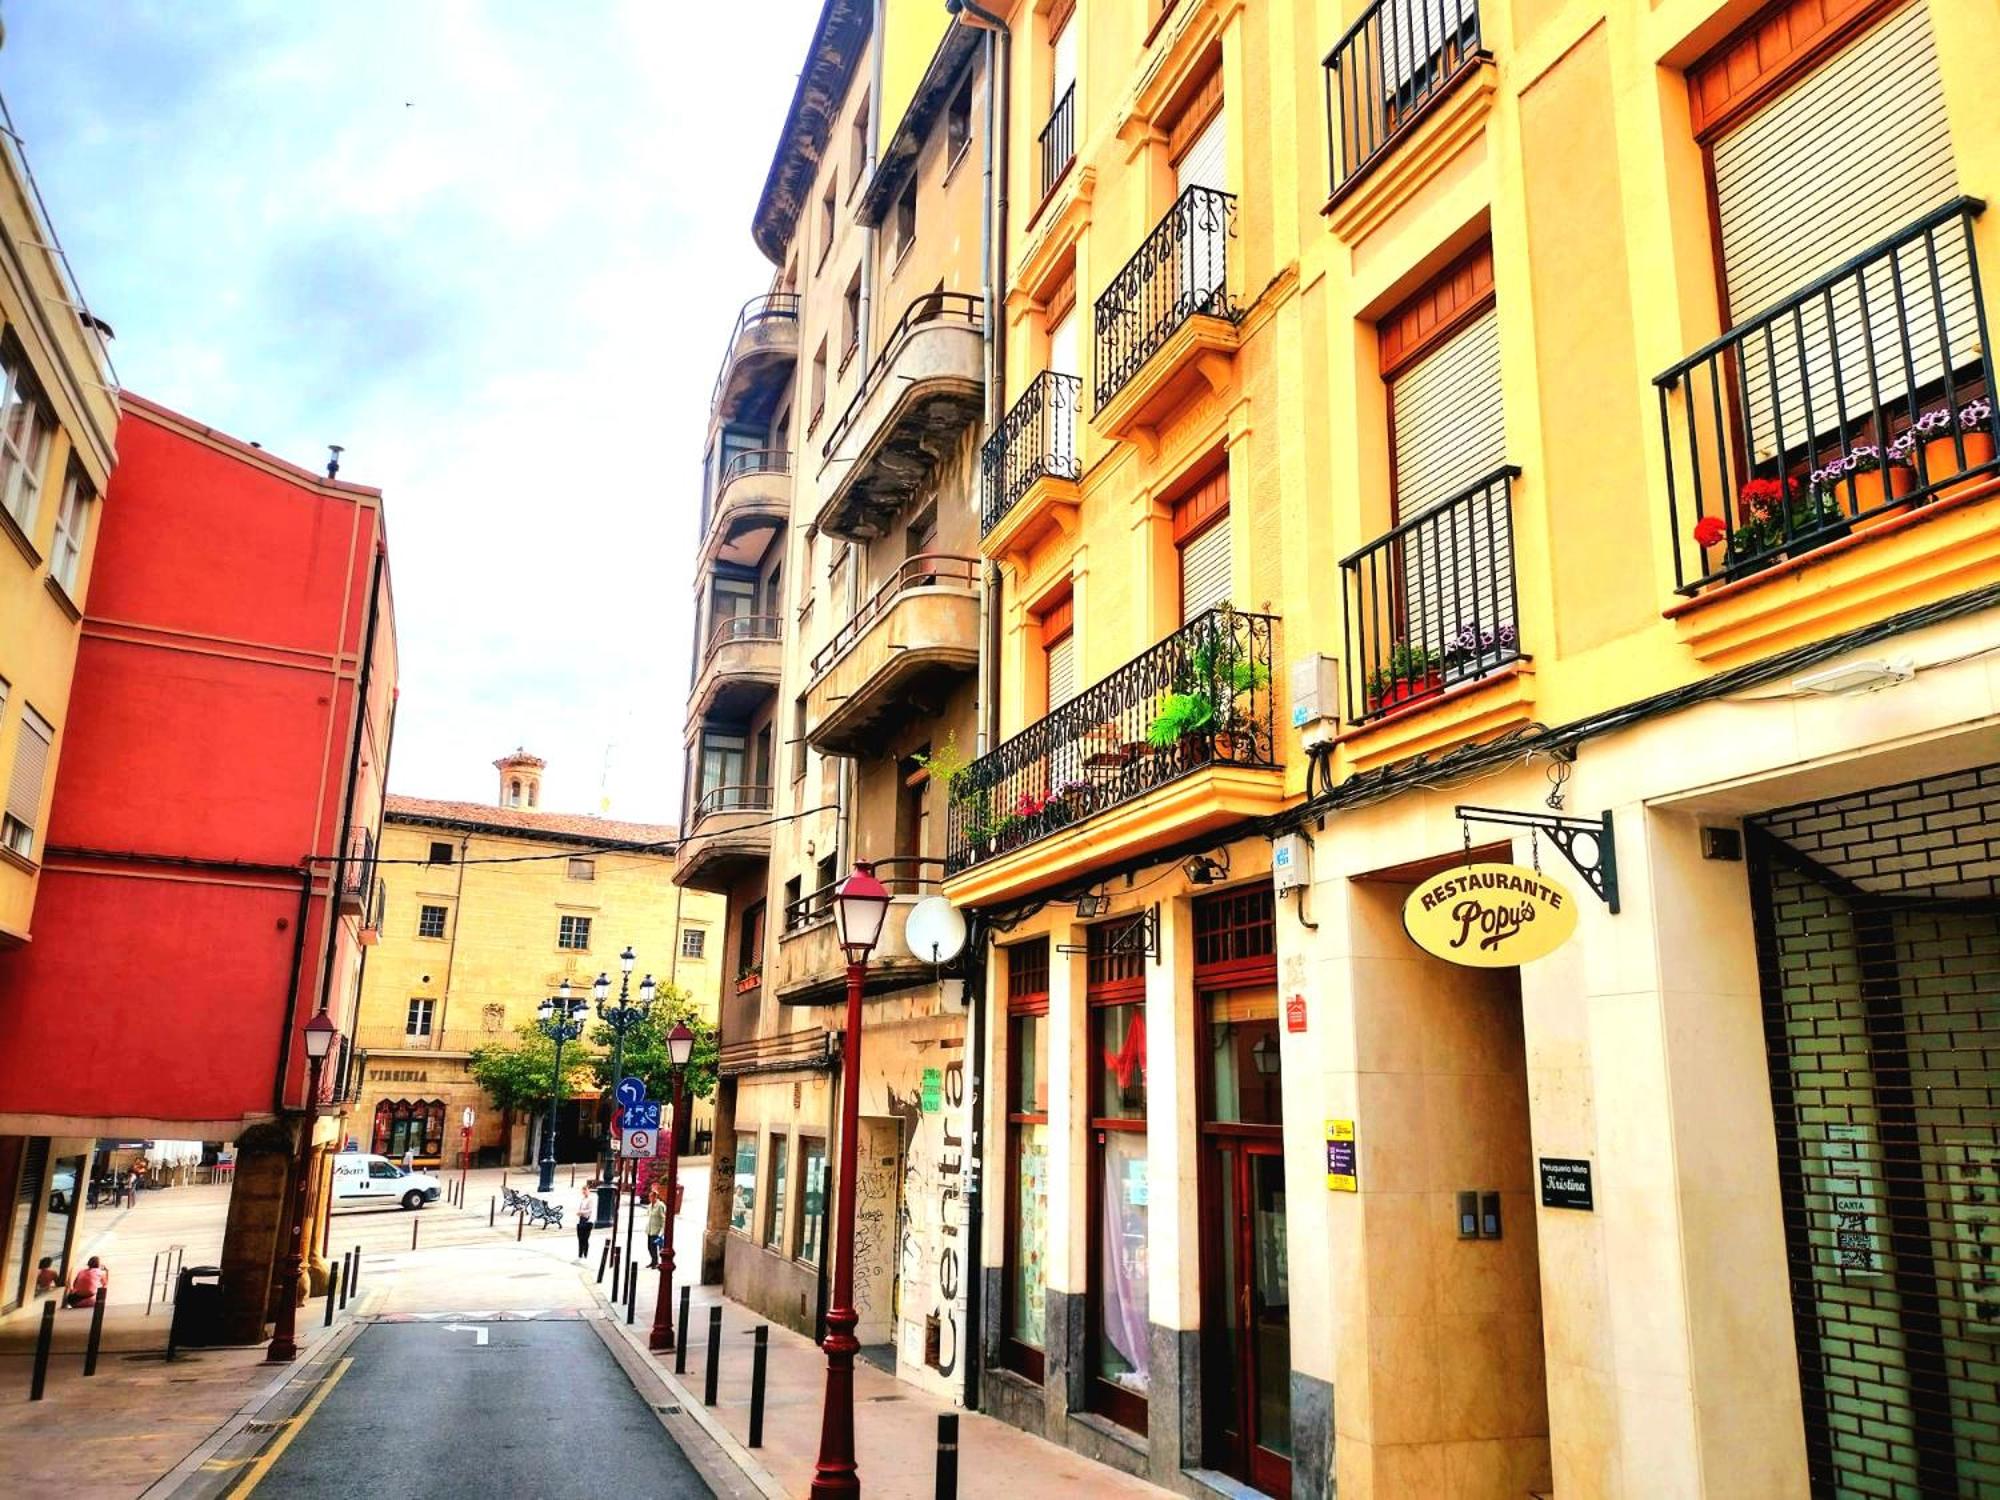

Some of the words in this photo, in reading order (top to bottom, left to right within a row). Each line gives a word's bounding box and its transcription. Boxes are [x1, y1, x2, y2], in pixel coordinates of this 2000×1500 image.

[1421, 873, 1563, 912] RESTAURANTE
[1449, 900, 1536, 951] Popy's
[370, 1070, 427, 1082] VIRGINIA
[1546, 1175, 1586, 1192] Kristina
[1838, 1201, 1865, 1211] CARTA
